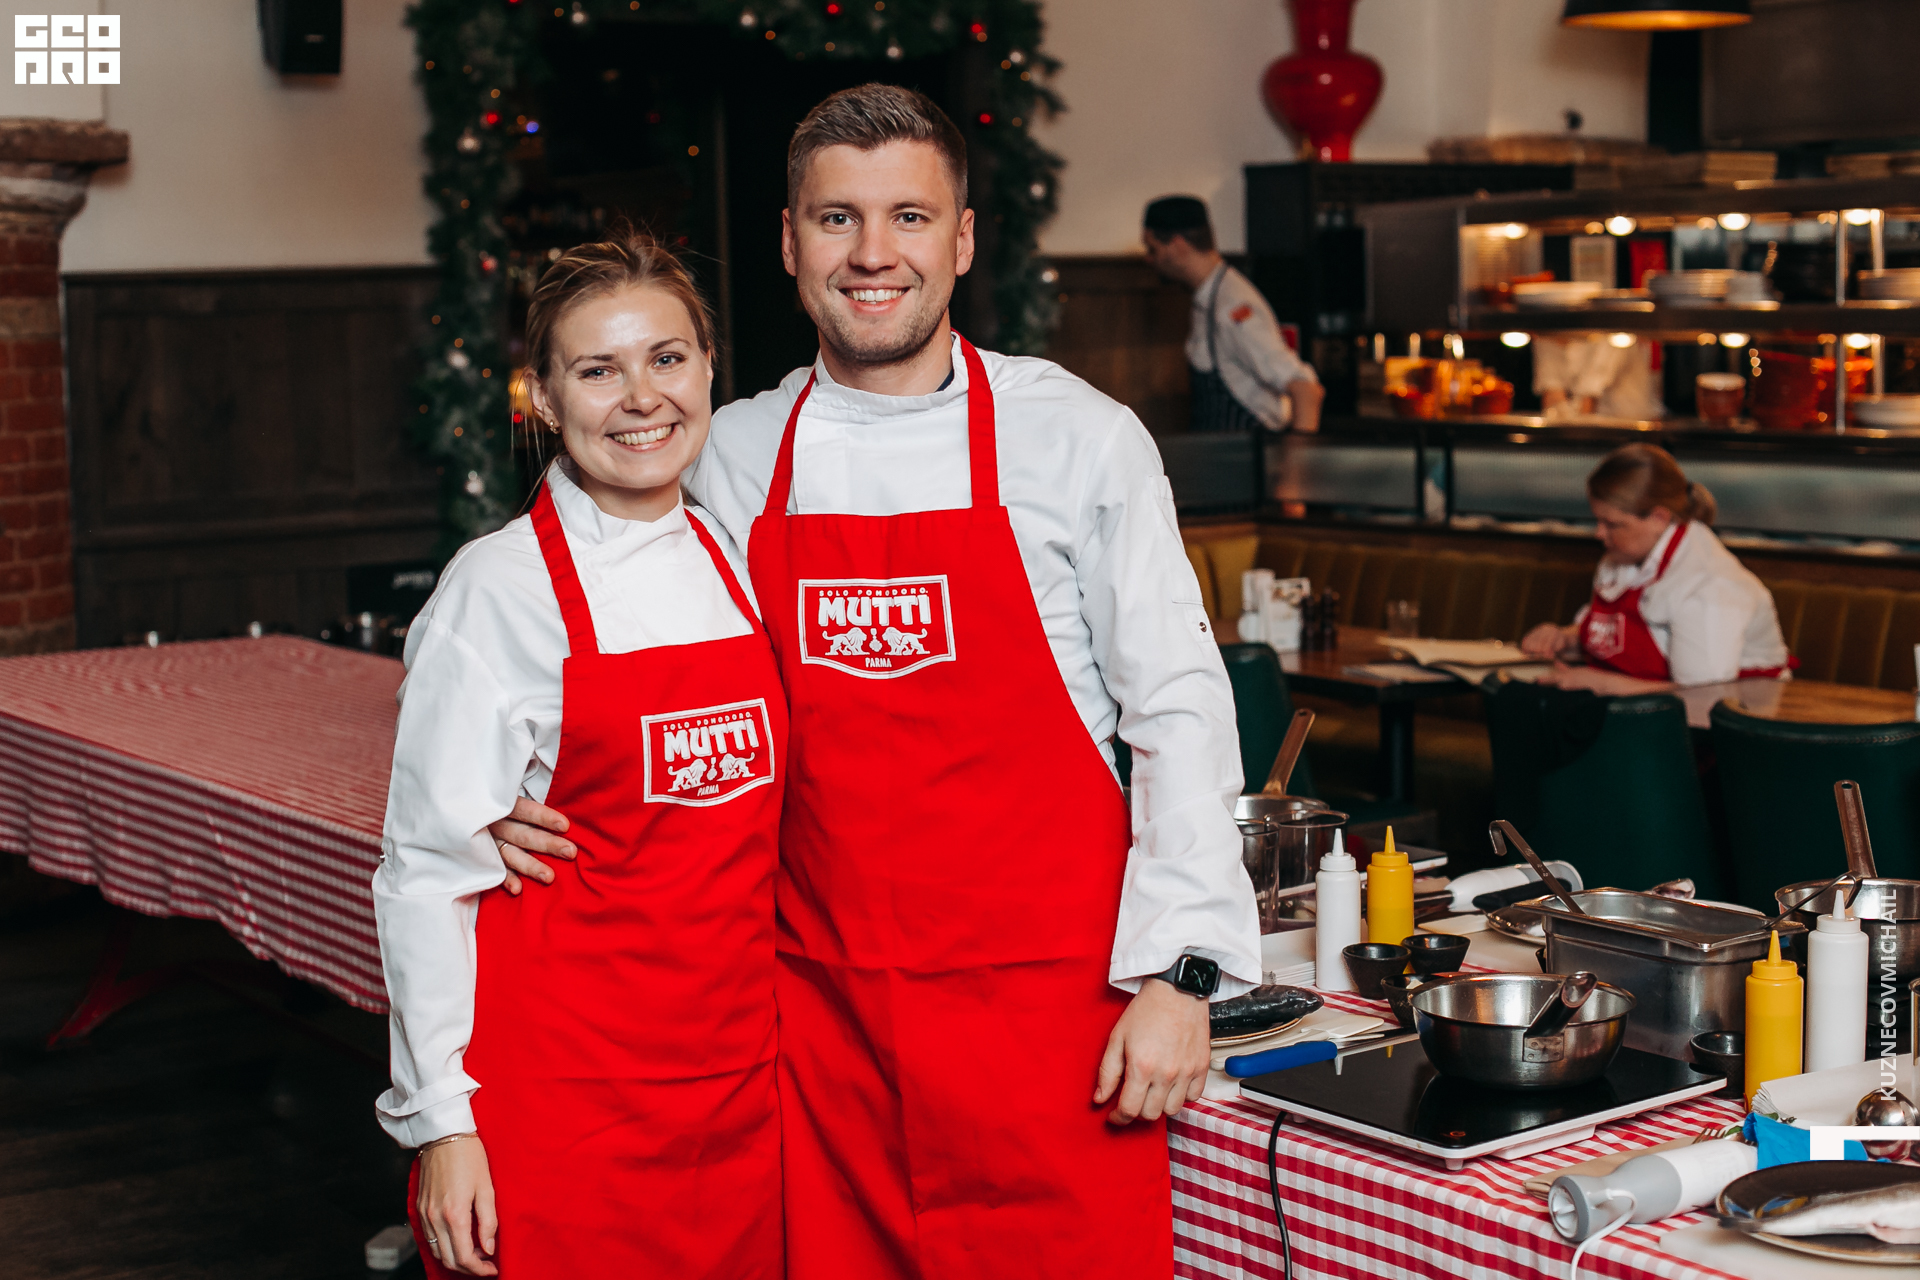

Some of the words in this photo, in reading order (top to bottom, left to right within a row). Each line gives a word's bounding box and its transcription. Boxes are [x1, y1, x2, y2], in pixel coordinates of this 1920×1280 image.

[819, 589, 849, 597] SOLO
[818, 595, 932, 626] MUTTI
[865, 657, 892, 668] PARMA
[662, 721, 690, 732] SOLO
[663, 718, 760, 762] MUTTI
[697, 784, 719, 797] PARMA
